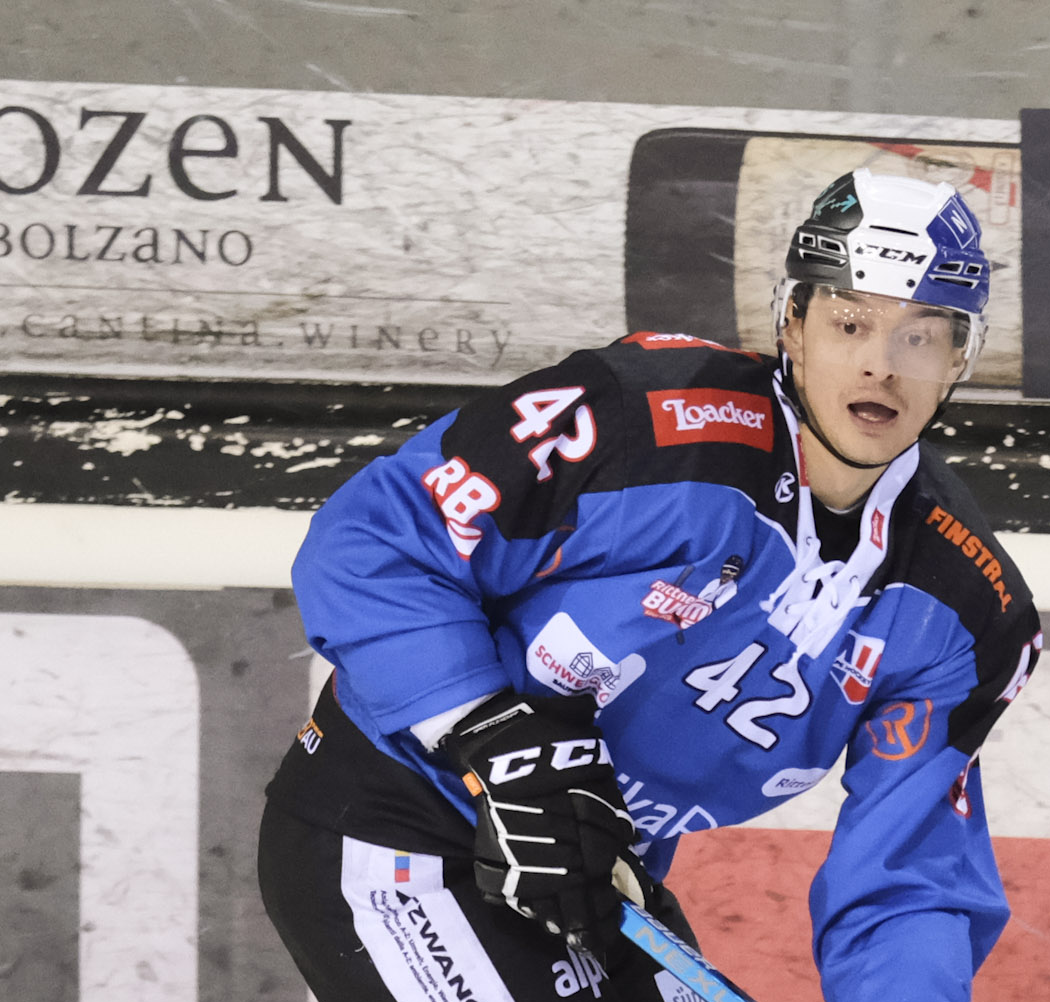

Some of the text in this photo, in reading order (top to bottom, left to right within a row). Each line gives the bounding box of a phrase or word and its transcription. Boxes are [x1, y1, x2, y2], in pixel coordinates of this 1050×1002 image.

[510, 386, 597, 482] 42
[661, 398, 766, 431] Loacker
[682, 641, 811, 751] 42
